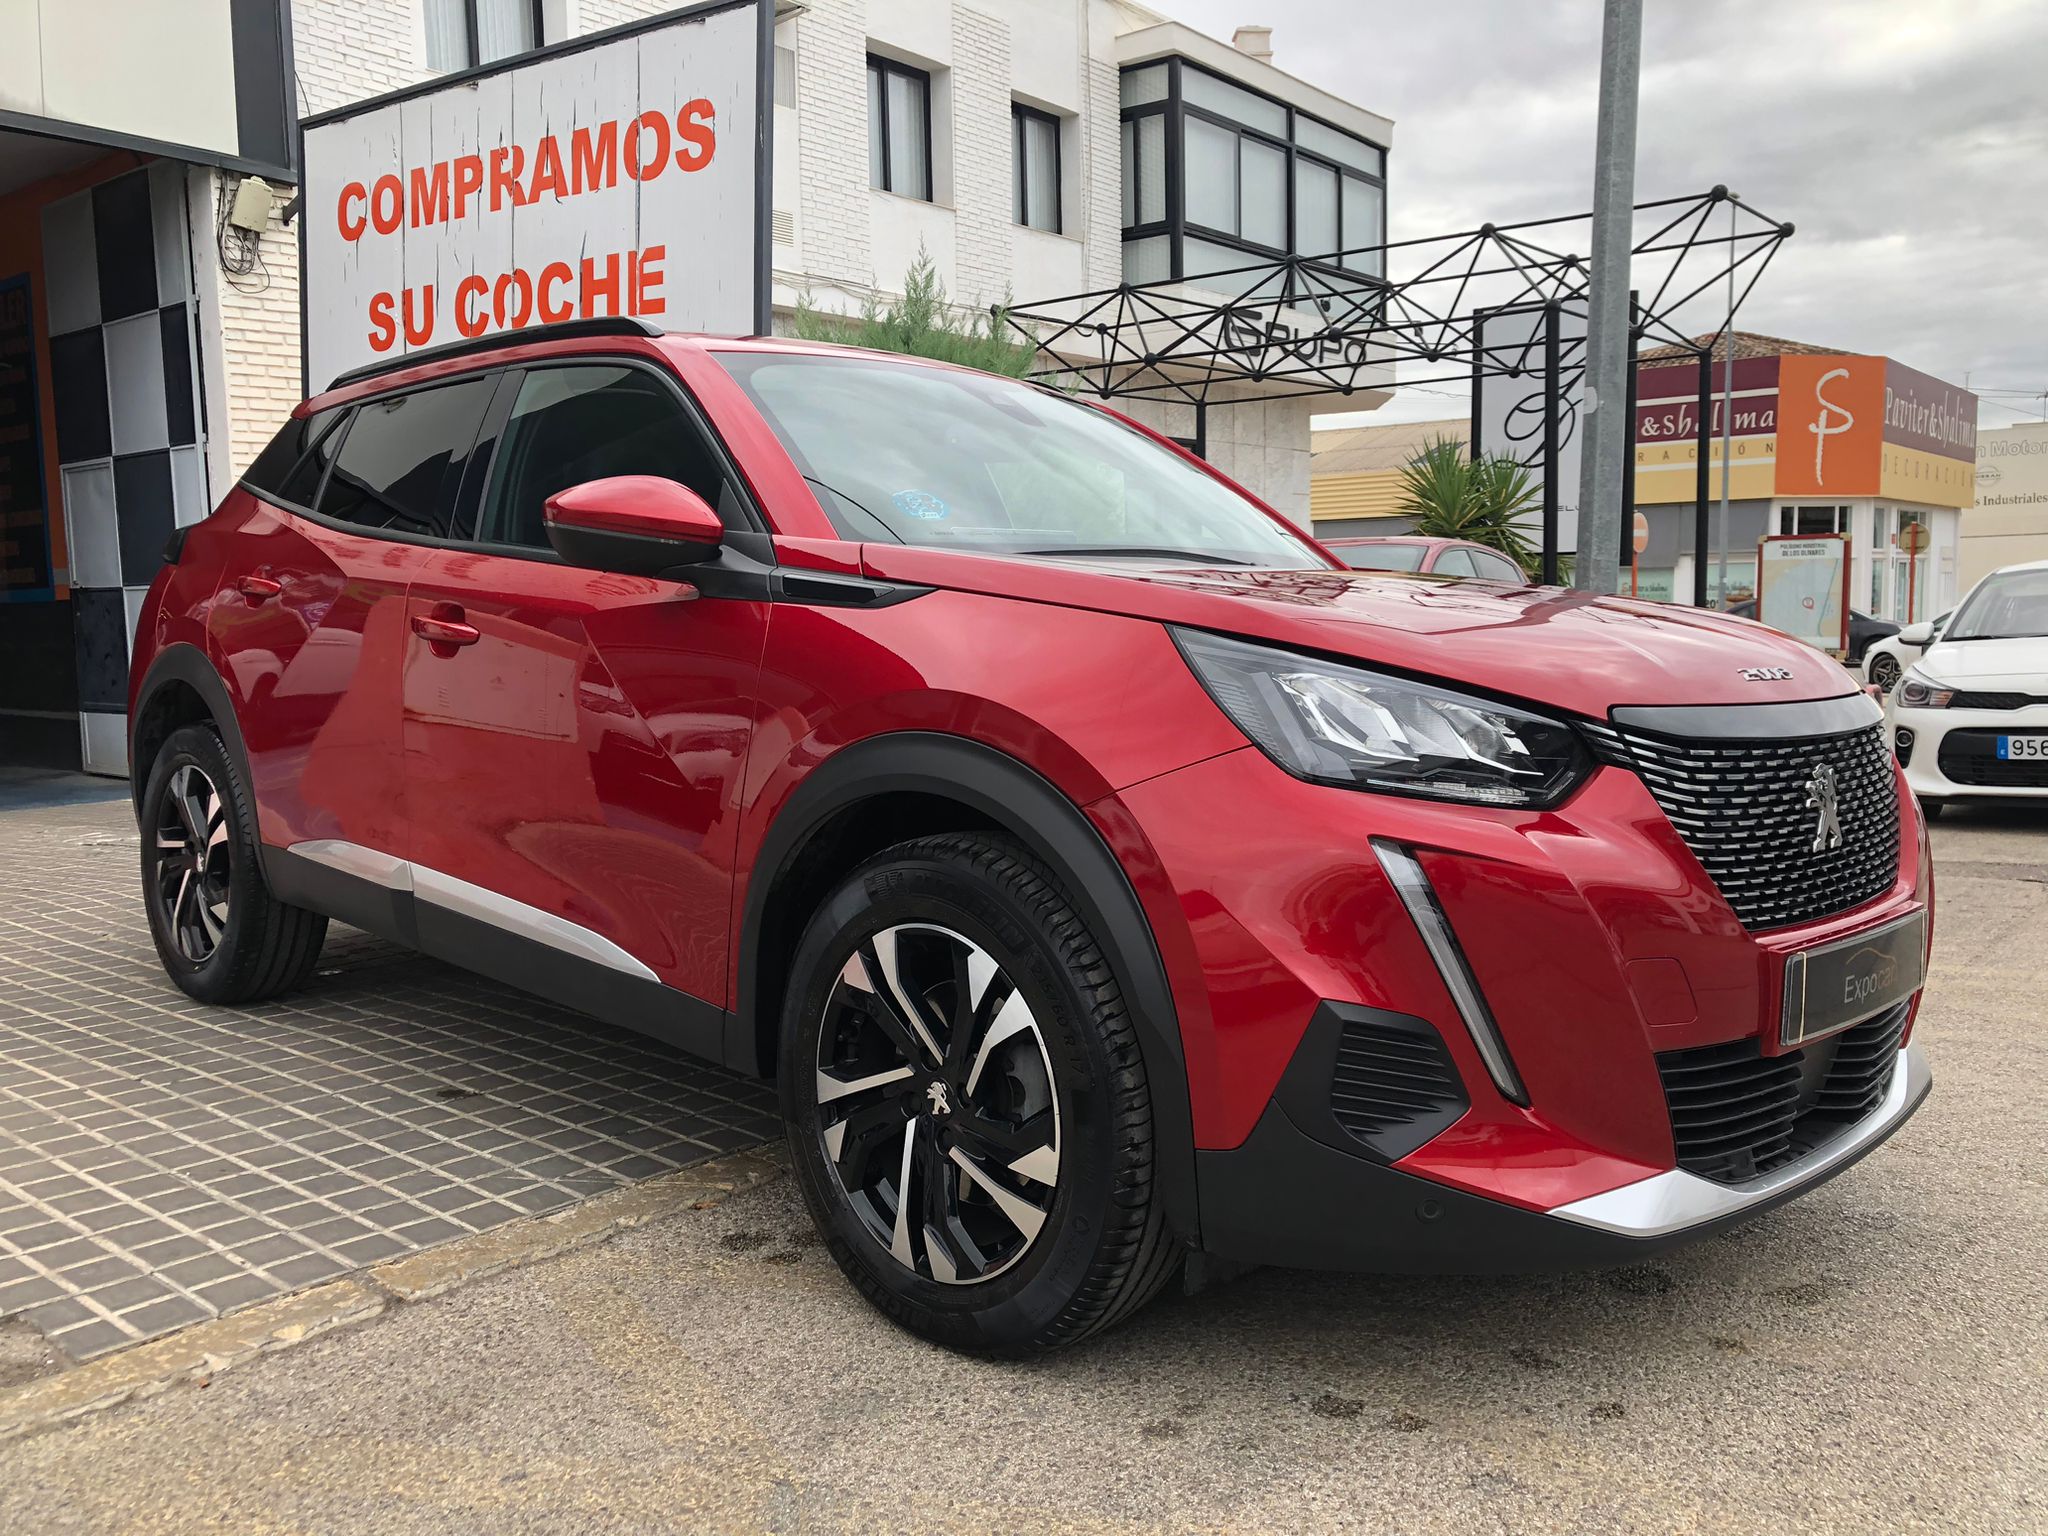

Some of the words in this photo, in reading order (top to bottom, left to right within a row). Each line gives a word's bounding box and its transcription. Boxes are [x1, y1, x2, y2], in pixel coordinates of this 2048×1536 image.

[337, 98, 717, 243] COMPRAMOS
[367, 284, 434, 352] SU
[455, 245, 669, 338] COCHE
[1983, 492, 2048, 506] Industriales
[2012, 739, 2048, 757] 956
[1843, 965, 1896, 1004] Expocar
